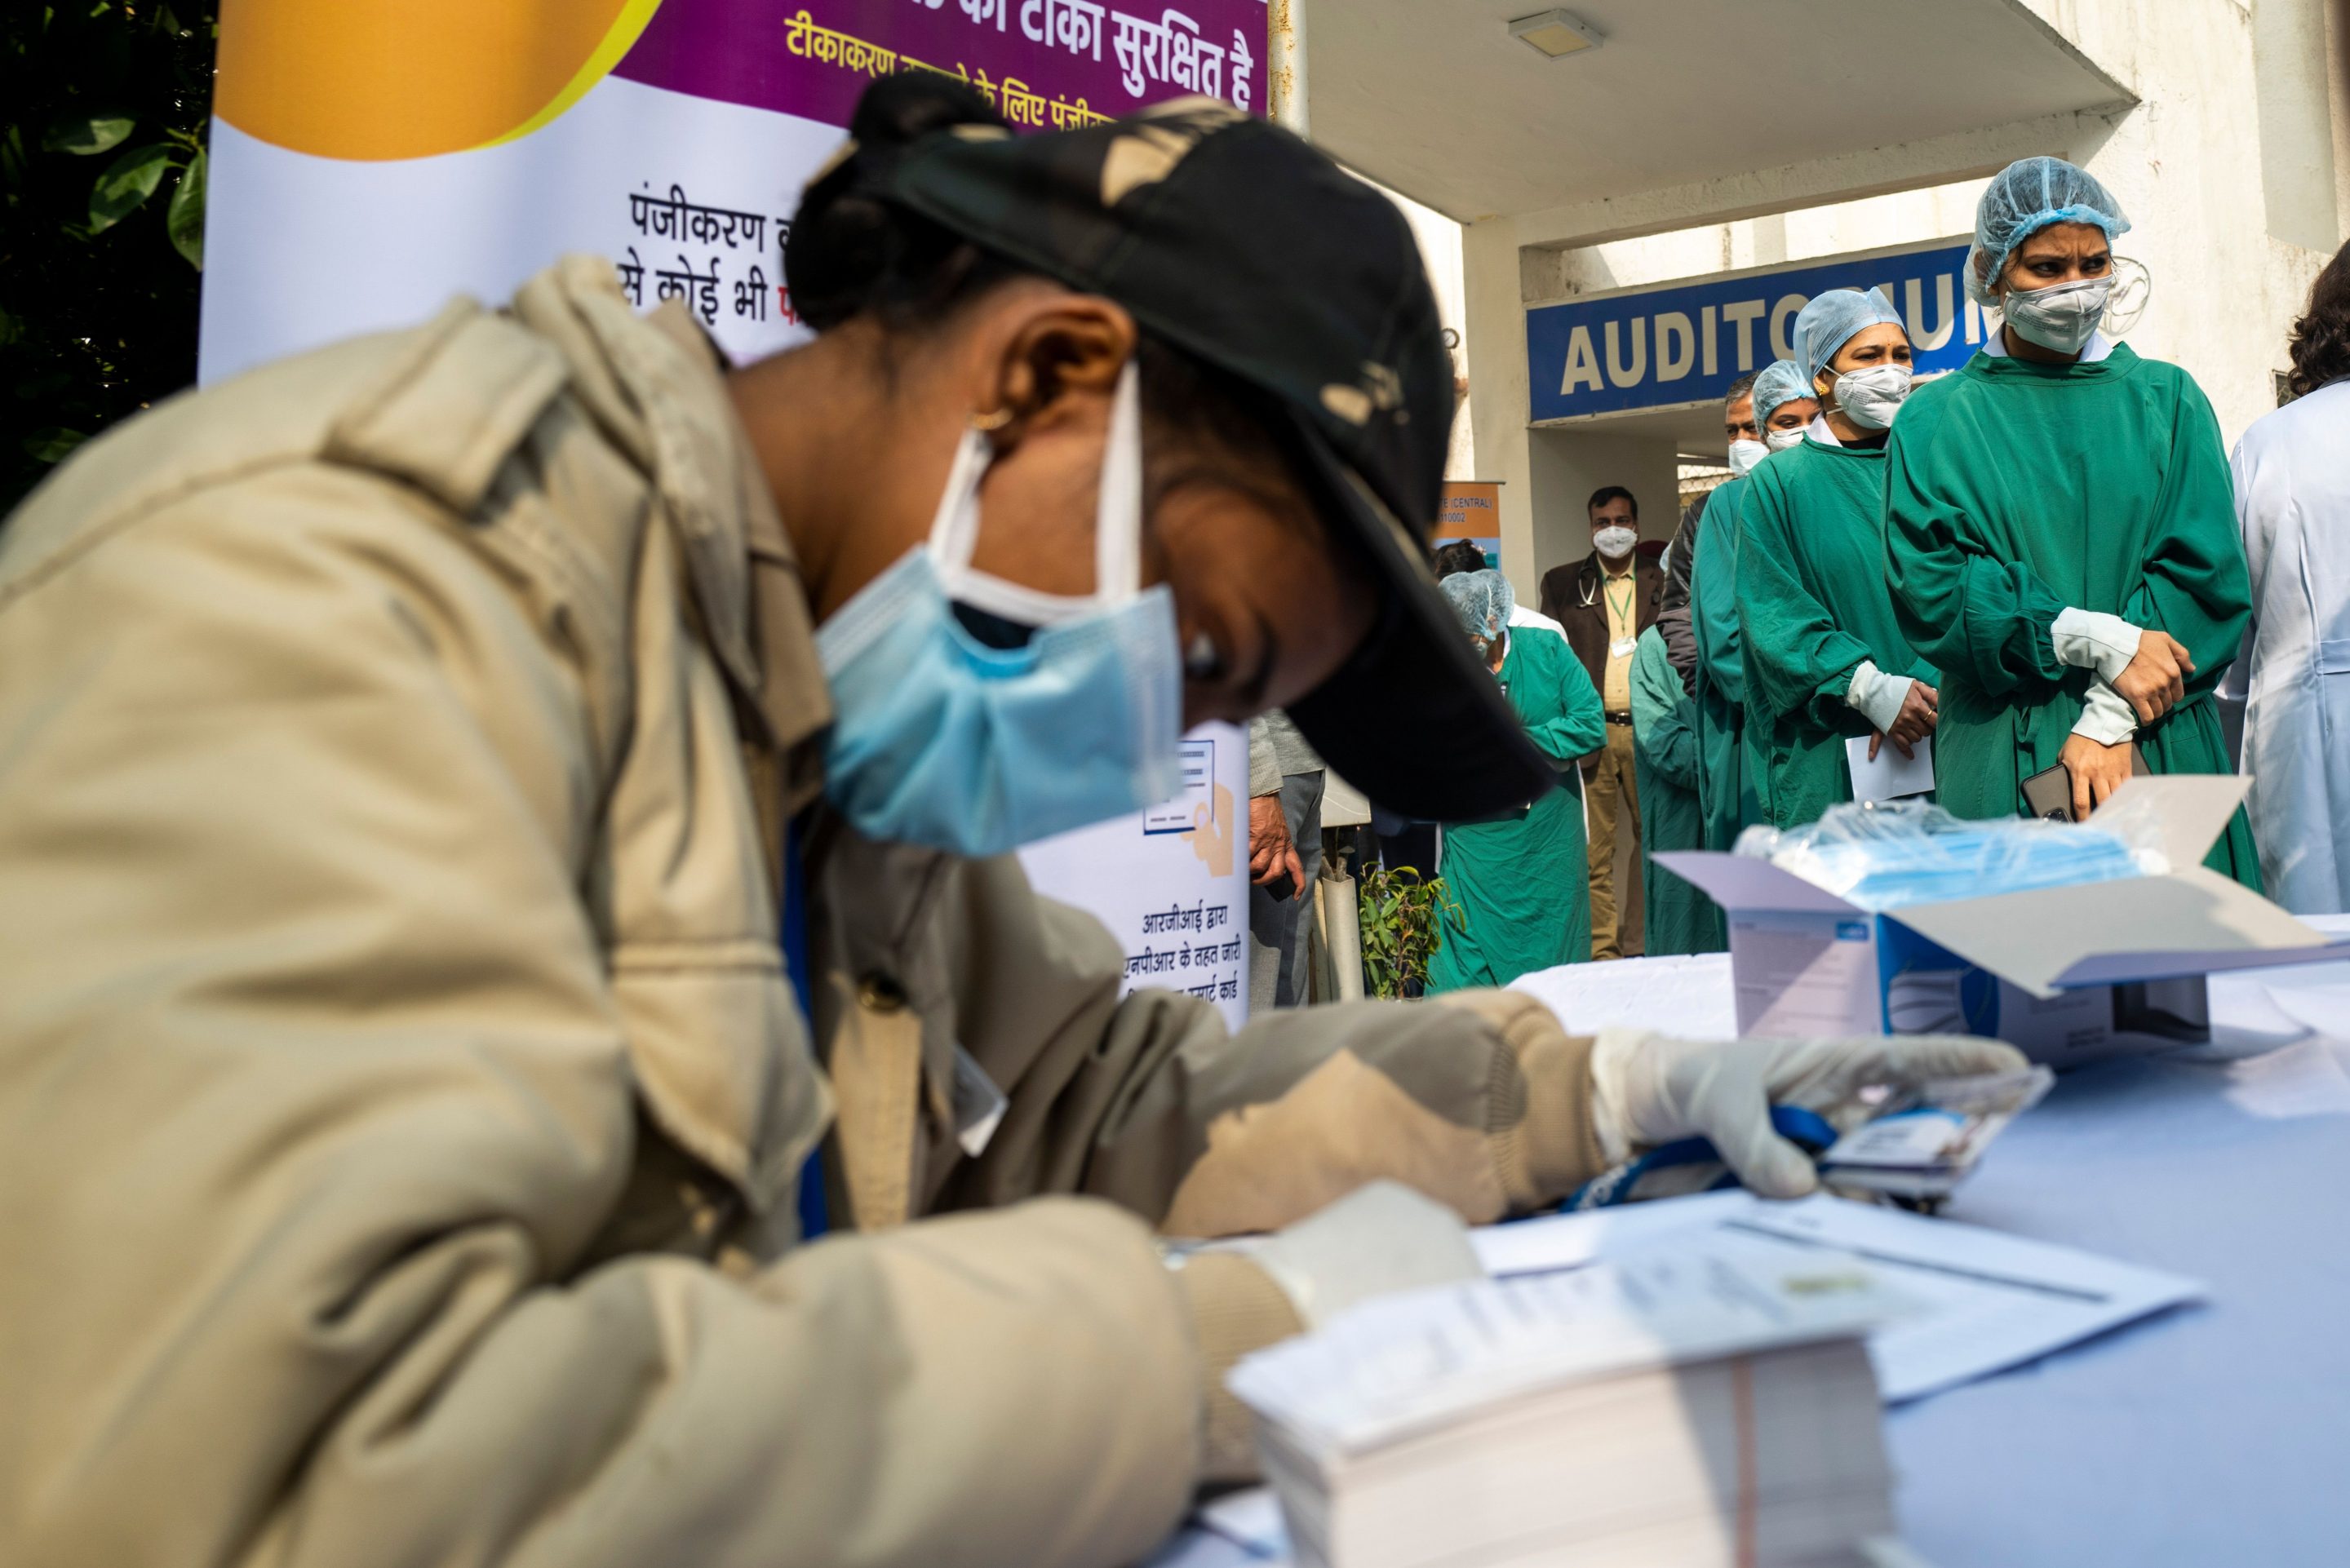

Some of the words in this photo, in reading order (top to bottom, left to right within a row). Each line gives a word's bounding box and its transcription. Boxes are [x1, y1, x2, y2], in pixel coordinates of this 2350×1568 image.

[784, 10, 897, 78] टीकाकरण
[1001, 78, 1046, 126] लिए
[1111, 9, 1224, 100] सुरक्षित
[1230, 29, 1254, 112] है
[629, 181, 766, 253] पंजीकरण
[655, 254, 720, 326] कोई
[734, 265, 768, 321] भी
[1142, 899, 1203, 933] आरजीआई
[1206, 905, 1228, 929] द्वारा
[1179, 941, 1191, 968] के
[1195, 945, 1218, 967] तहत
[1222, 932, 1241, 962] जारी
[1219, 969, 1238, 1000] कार्ड
